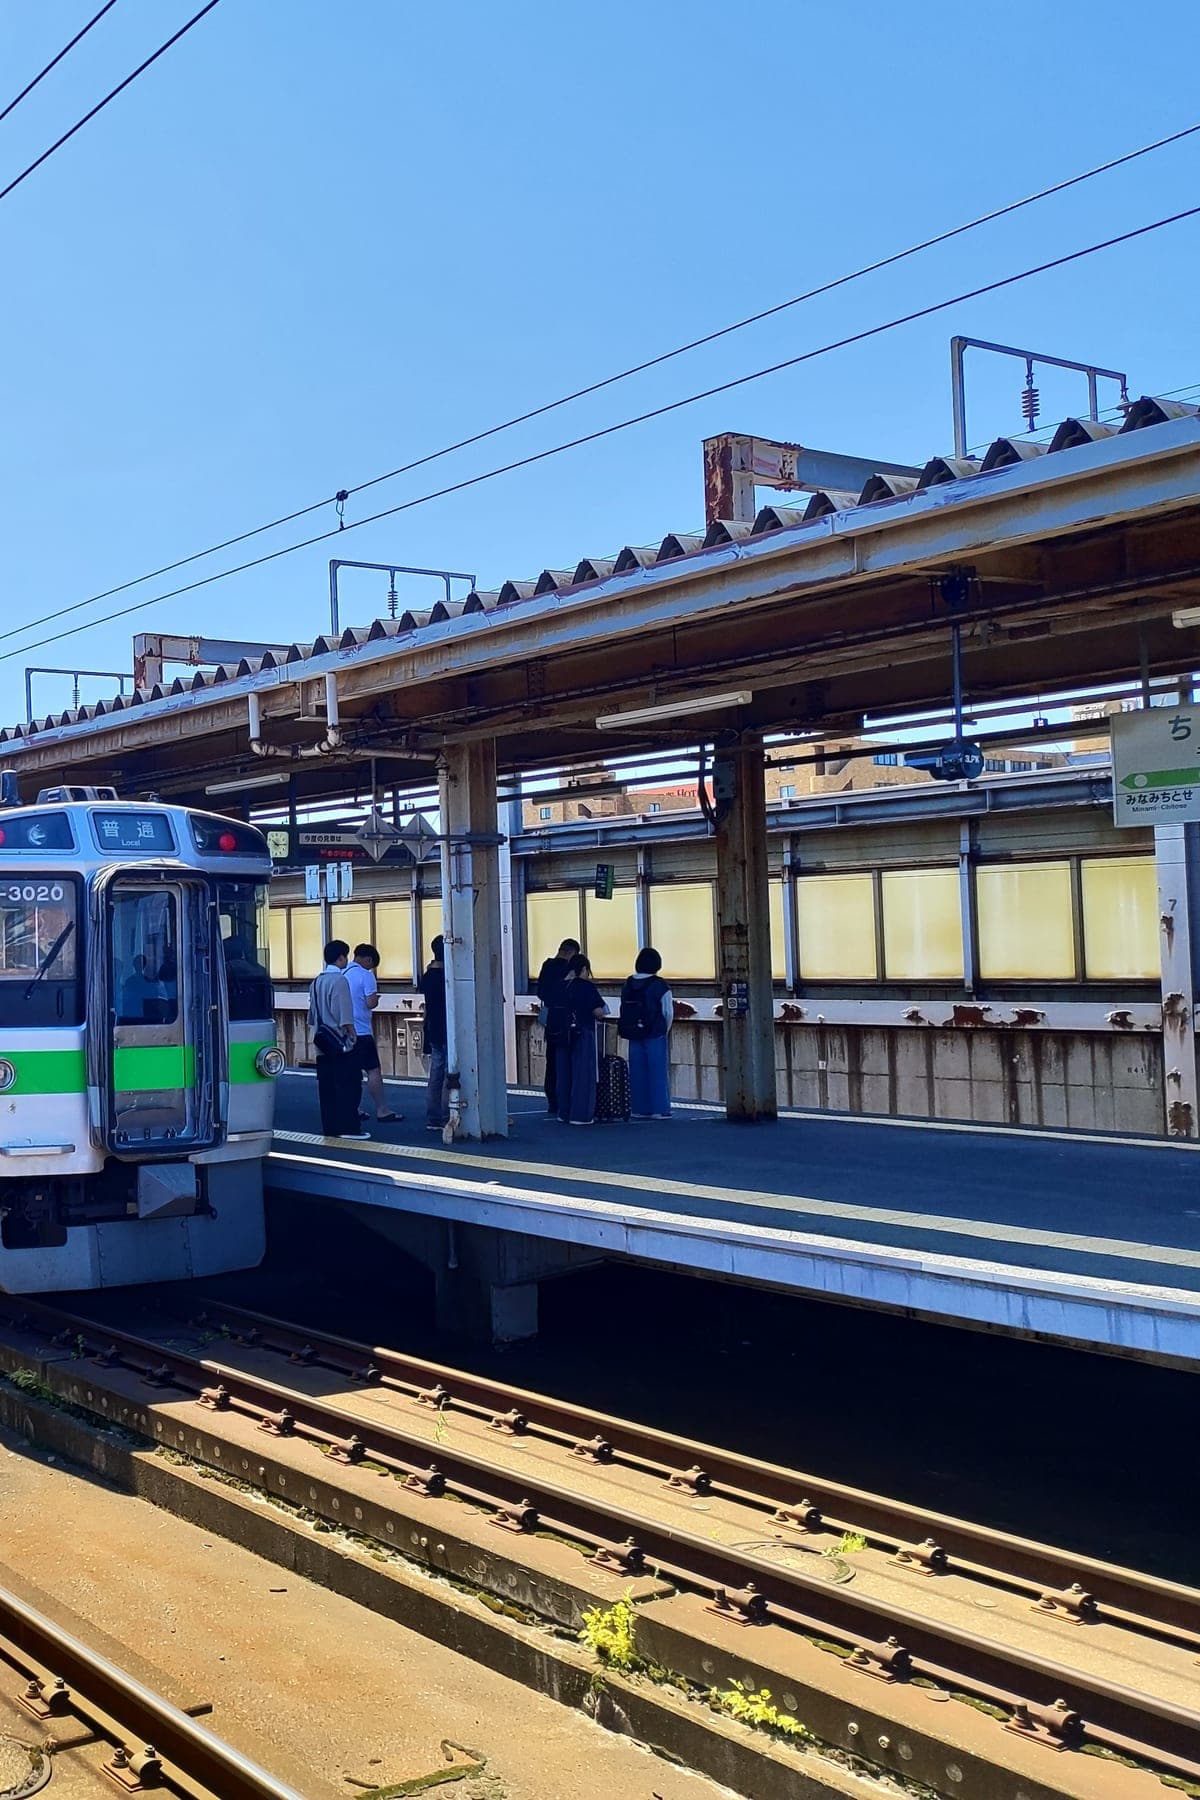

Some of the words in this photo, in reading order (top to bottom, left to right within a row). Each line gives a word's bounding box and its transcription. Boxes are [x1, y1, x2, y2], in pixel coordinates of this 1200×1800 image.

[1168, 715, 1192, 741] ち
[1126, 789, 1194, 805] みなみちとせ
[101, 819, 155, 838] 普通
[1168, 899, 1177, 912] 7
